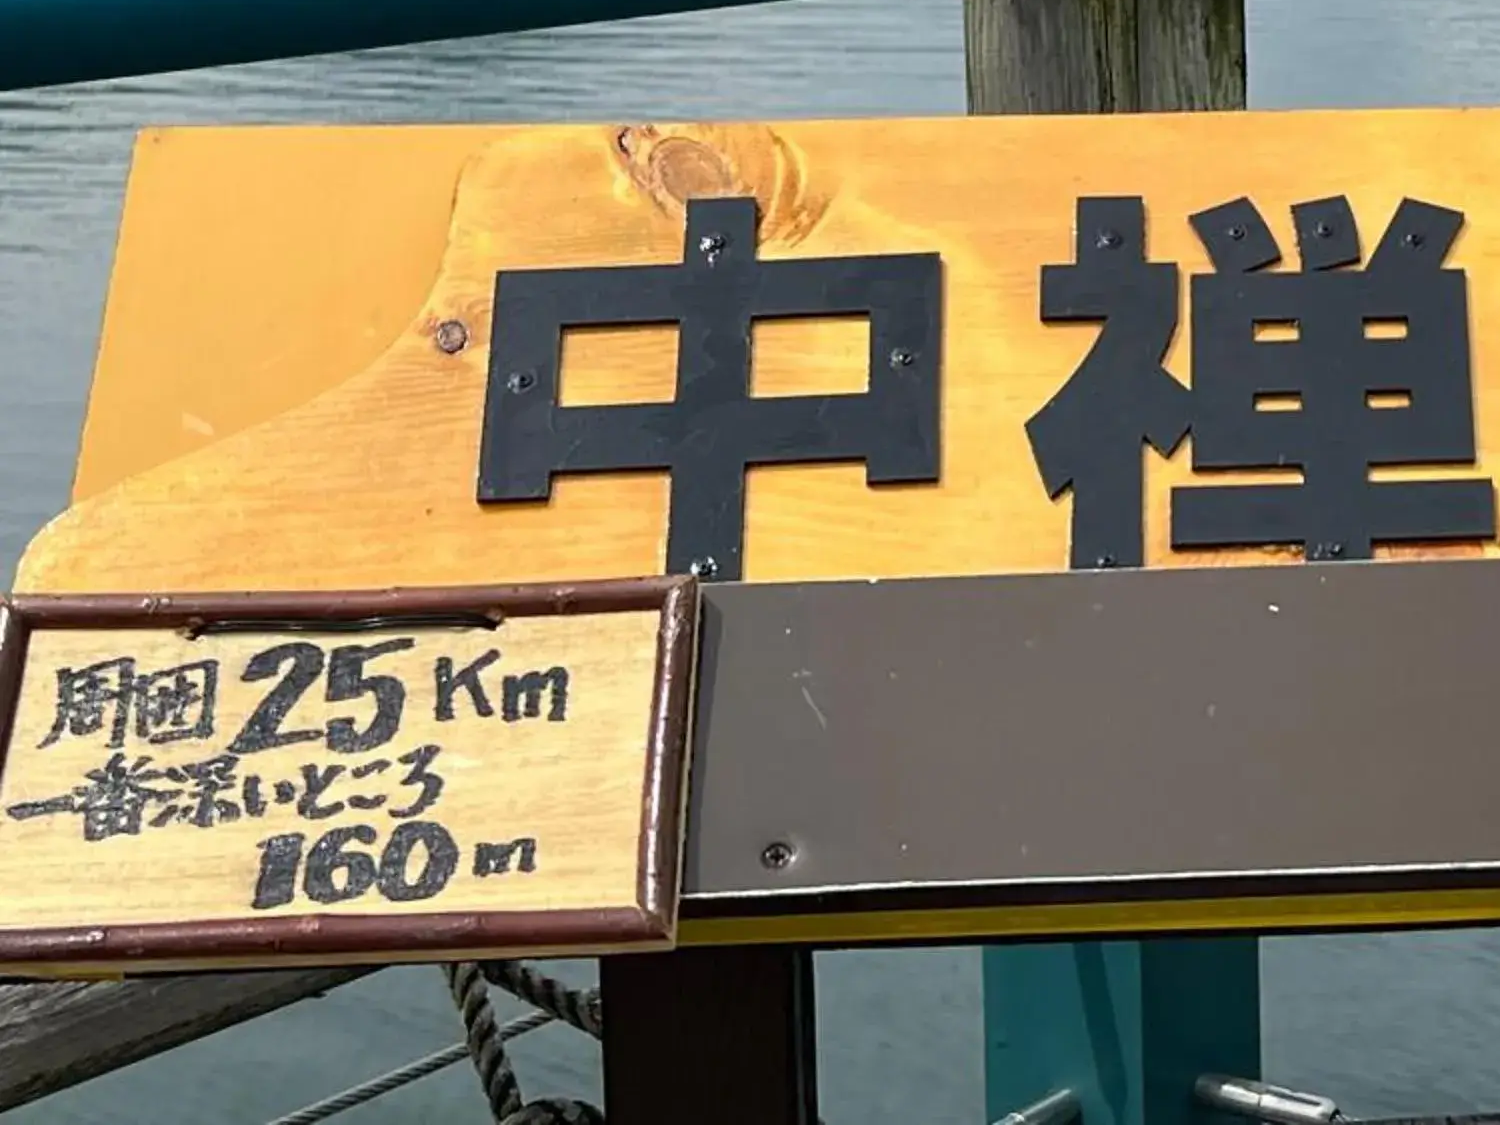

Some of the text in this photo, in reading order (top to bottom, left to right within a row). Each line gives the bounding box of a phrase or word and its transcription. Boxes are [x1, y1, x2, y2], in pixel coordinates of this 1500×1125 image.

[7, 743, 445, 840] 一番深いところ
